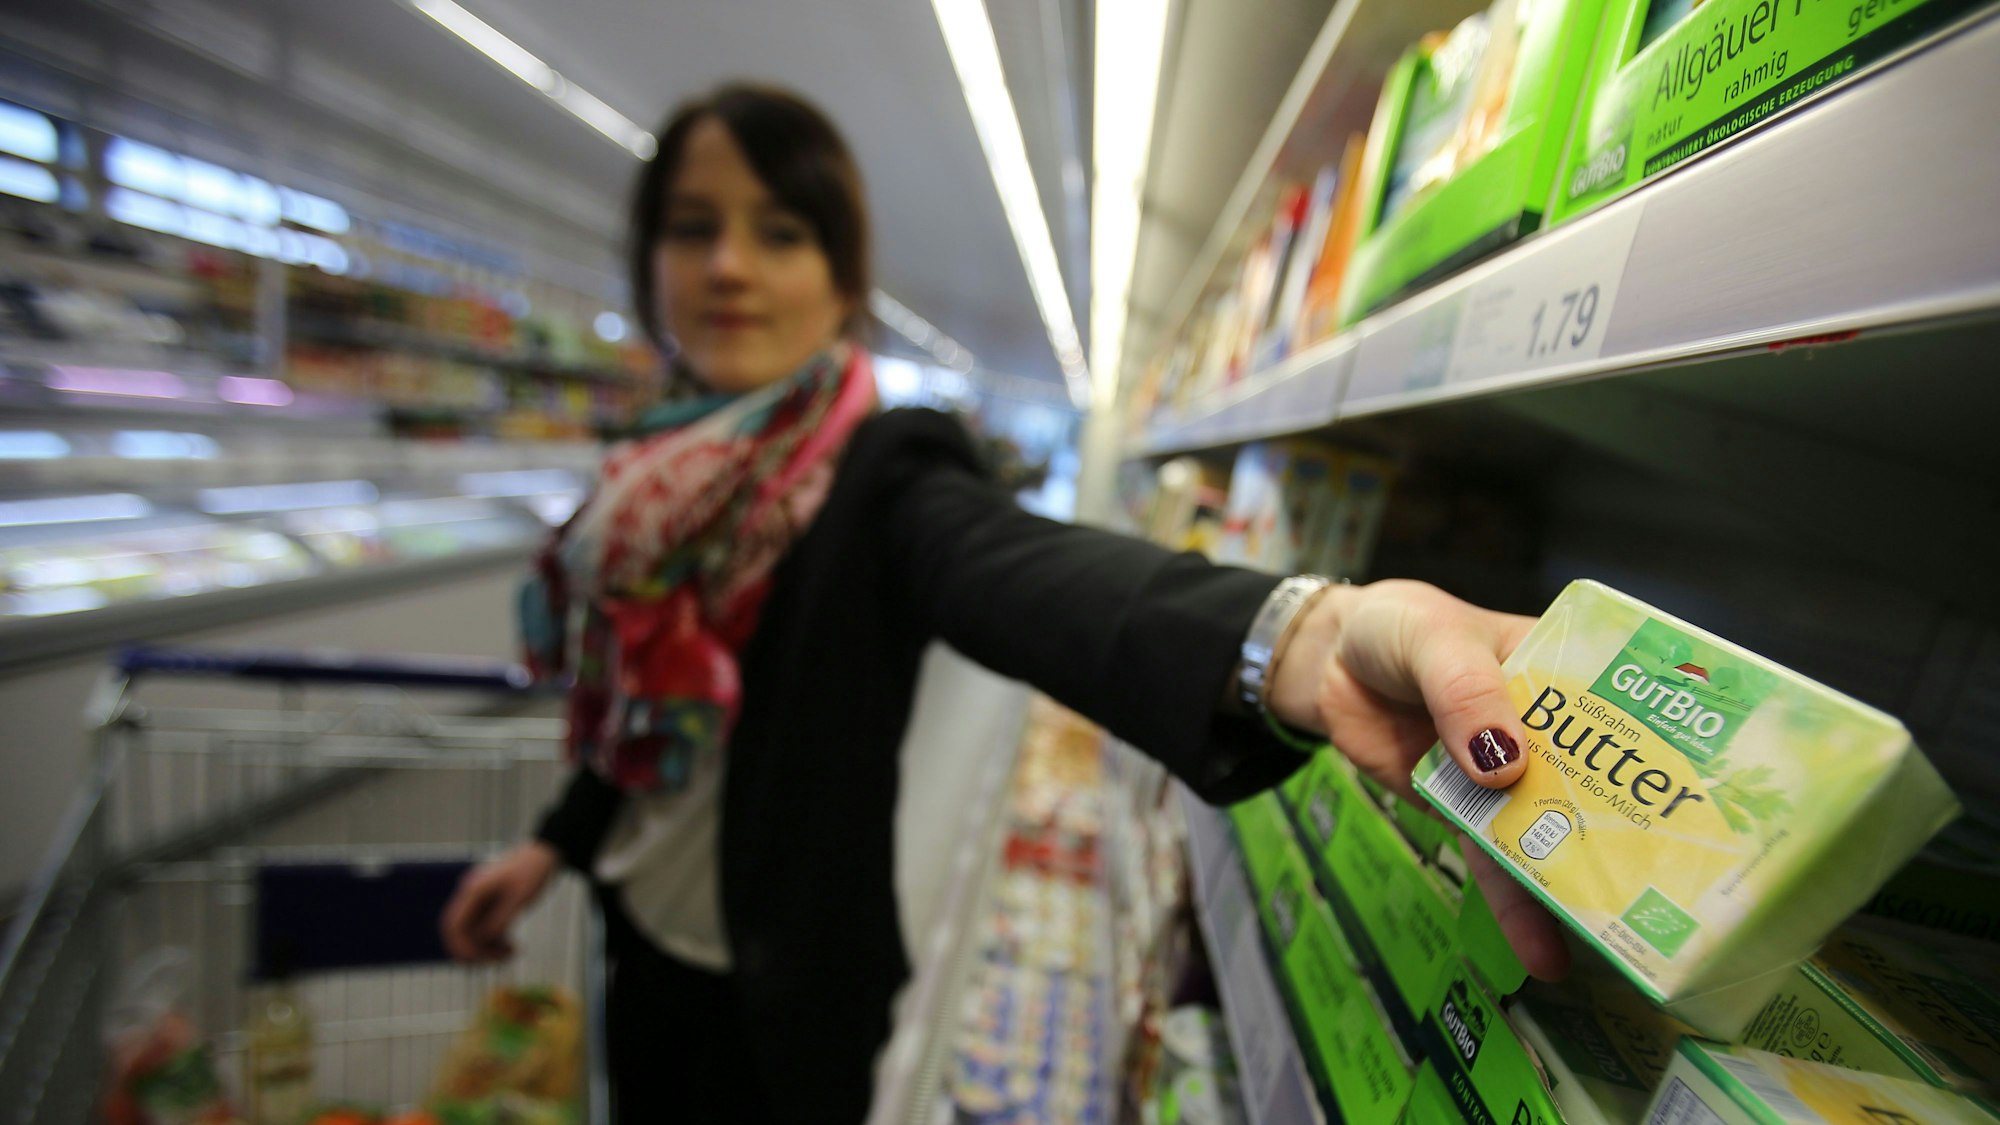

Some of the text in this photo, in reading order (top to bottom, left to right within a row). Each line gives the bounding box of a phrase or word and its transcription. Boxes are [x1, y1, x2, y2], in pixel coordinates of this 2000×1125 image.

[1846, 0, 1906, 38] ger
[1652, 0, 1781, 111] Allgäuer
[1723, 50, 1789, 104] rahmig
[1706, 99, 1776, 145] ÖKOLOGISCHE
[1778, 54, 1856, 106] ERZEUGUNG
[1646, 114, 1683, 148] natur
[1527, 283, 1600, 358] 1.79
[1573, 695, 1642, 743] Süßrahm
[1520, 686, 1706, 819] Butter
[1539, 797, 1562, 807] Portion
[1540, 750, 1581, 780] reiner
[1580, 775, 1653, 831] Bio-Milch
[1540, 823, 1551, 834] 610
[1540, 837, 1554, 849] kcal
[1443, 1000, 1477, 1061] GUTBIO
